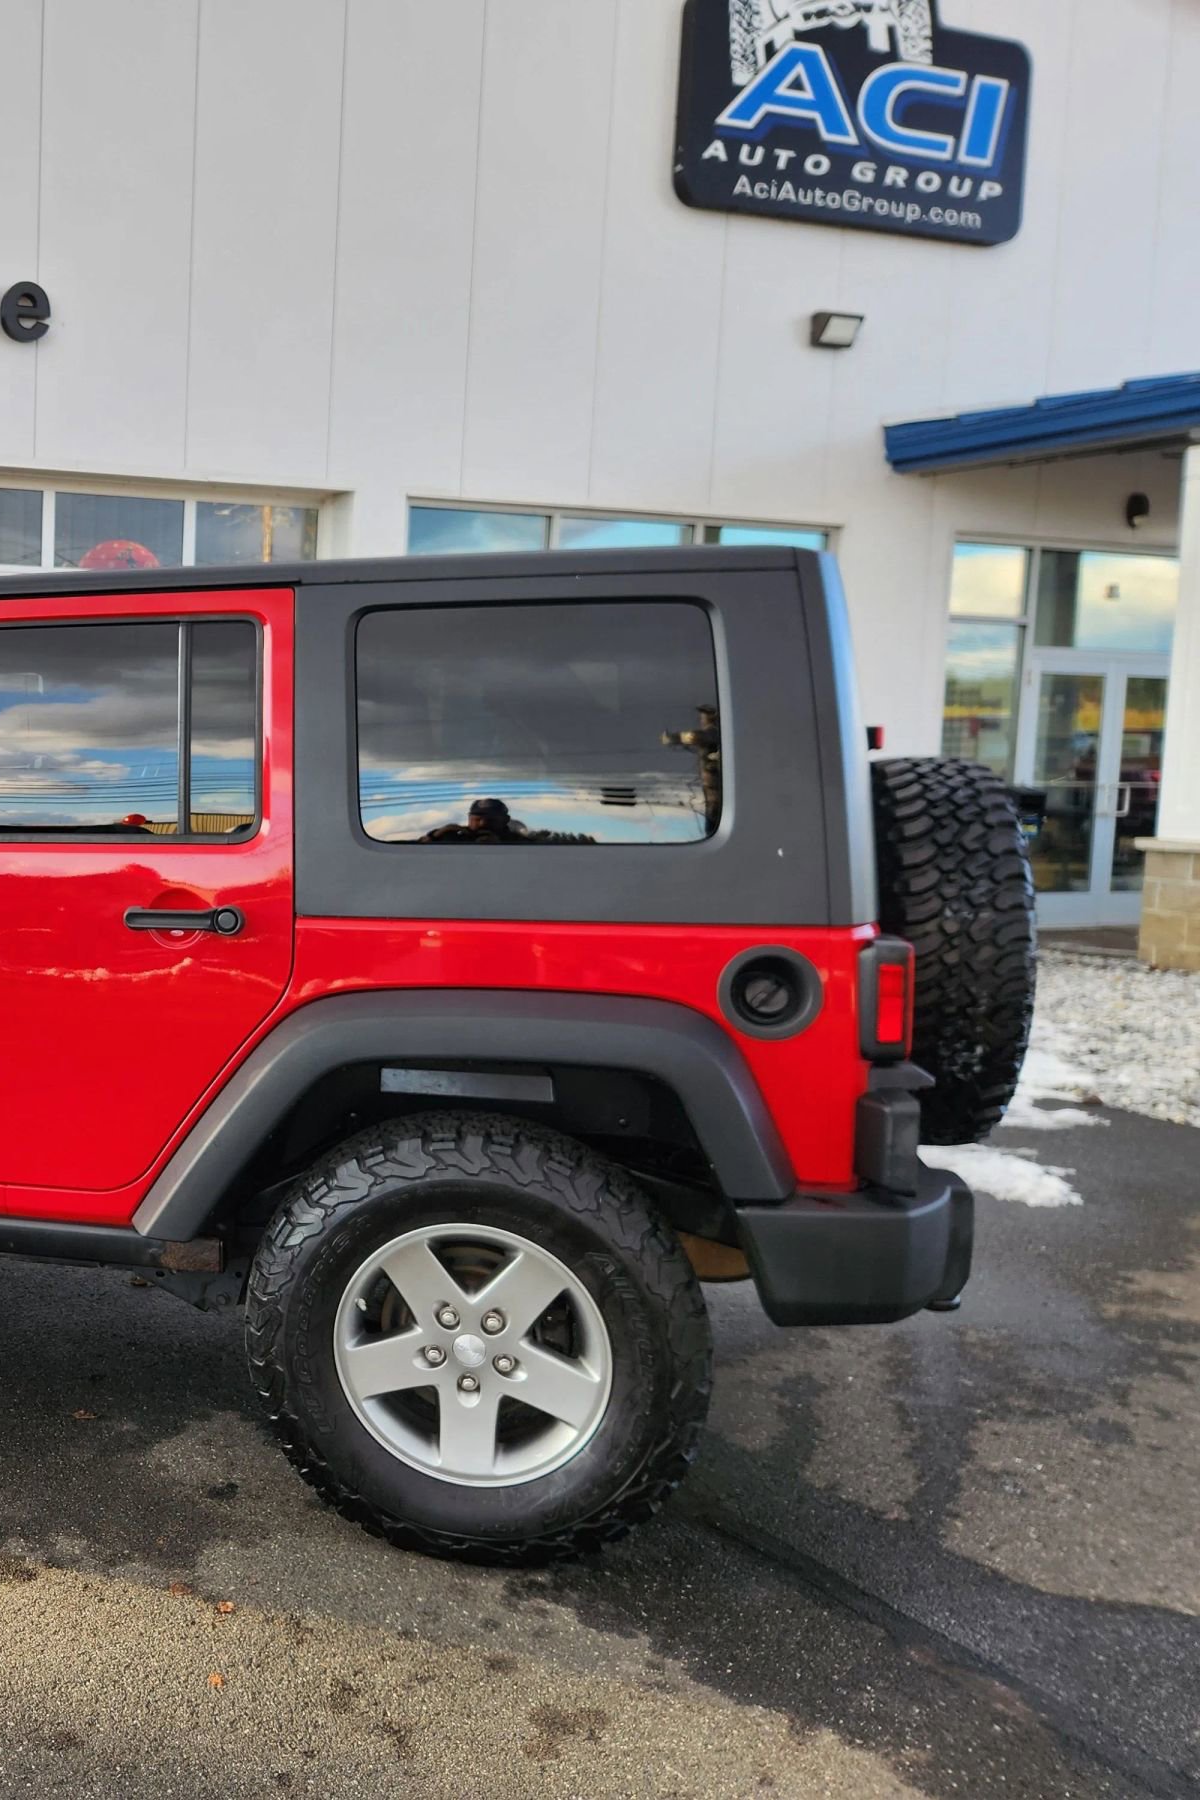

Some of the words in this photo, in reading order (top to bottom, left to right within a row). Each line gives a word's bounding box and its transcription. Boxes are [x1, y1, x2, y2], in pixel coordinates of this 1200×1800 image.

[714, 40, 1009, 168] ACI
[701, 138, 832, 176] AUTO
[851, 160, 1004, 200] GROUP
[732, 174, 982, 230] AciAutoGroup.com
